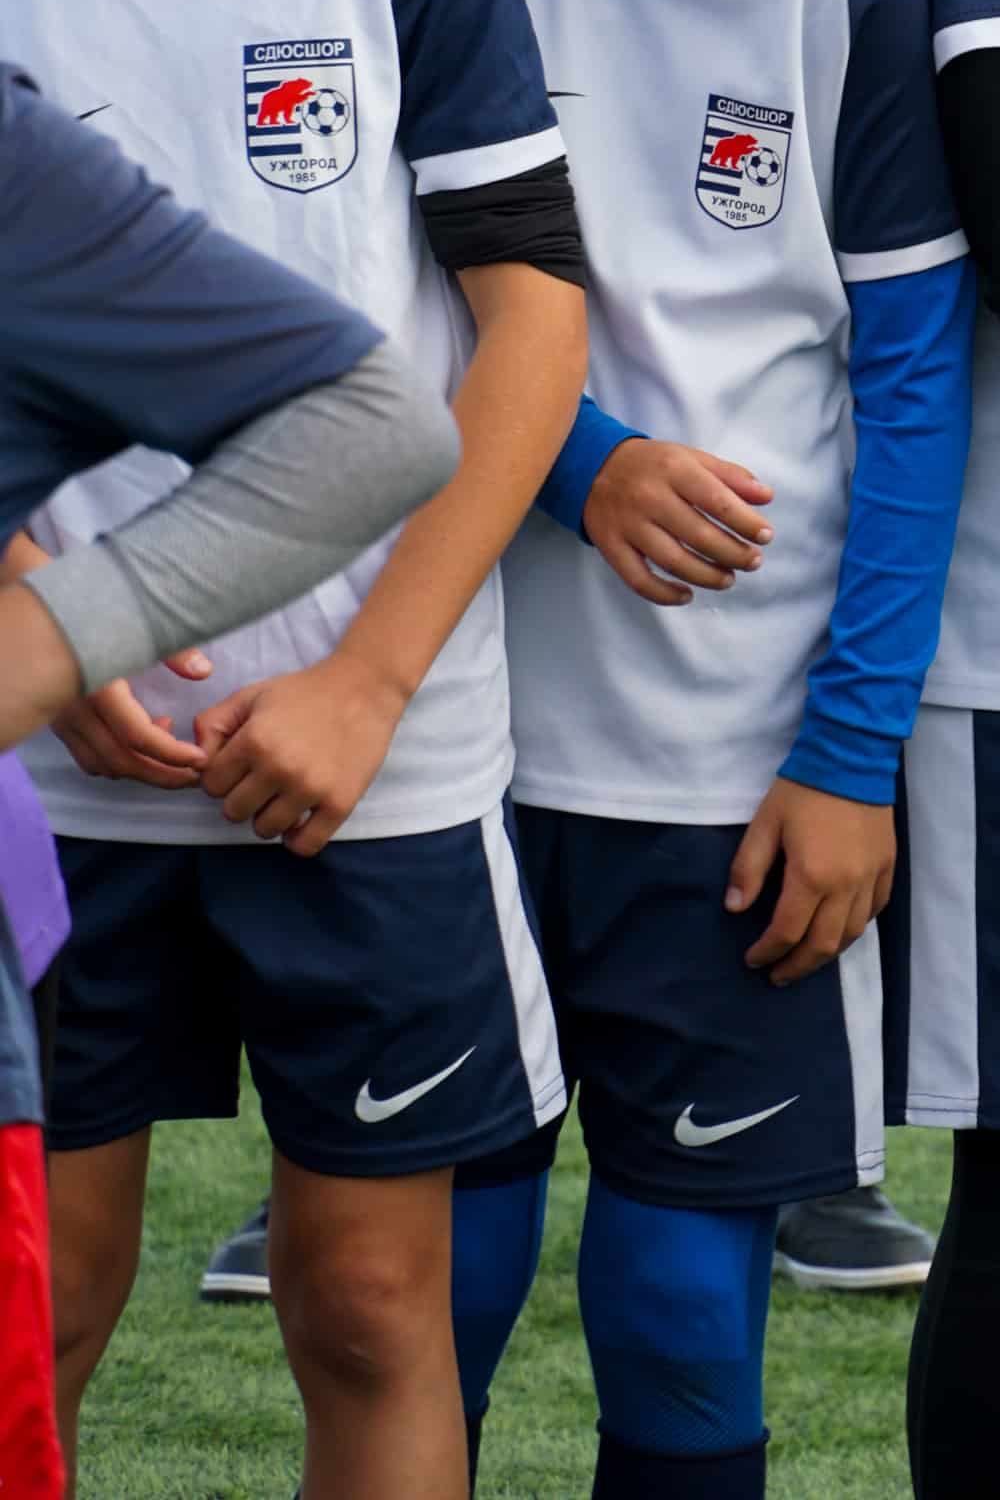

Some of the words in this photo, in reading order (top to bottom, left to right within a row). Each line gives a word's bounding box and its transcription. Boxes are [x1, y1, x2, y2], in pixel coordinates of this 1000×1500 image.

[254, 42, 345, 62] СДЮСШОР
[717, 99, 787, 124] СДЮСШОР
[269, 158, 338, 172] УЖГОРОД
[289, 173, 317, 183] 1985
[712, 196, 766, 216] УЖГОРОД
[725, 210, 748, 221] 1985
